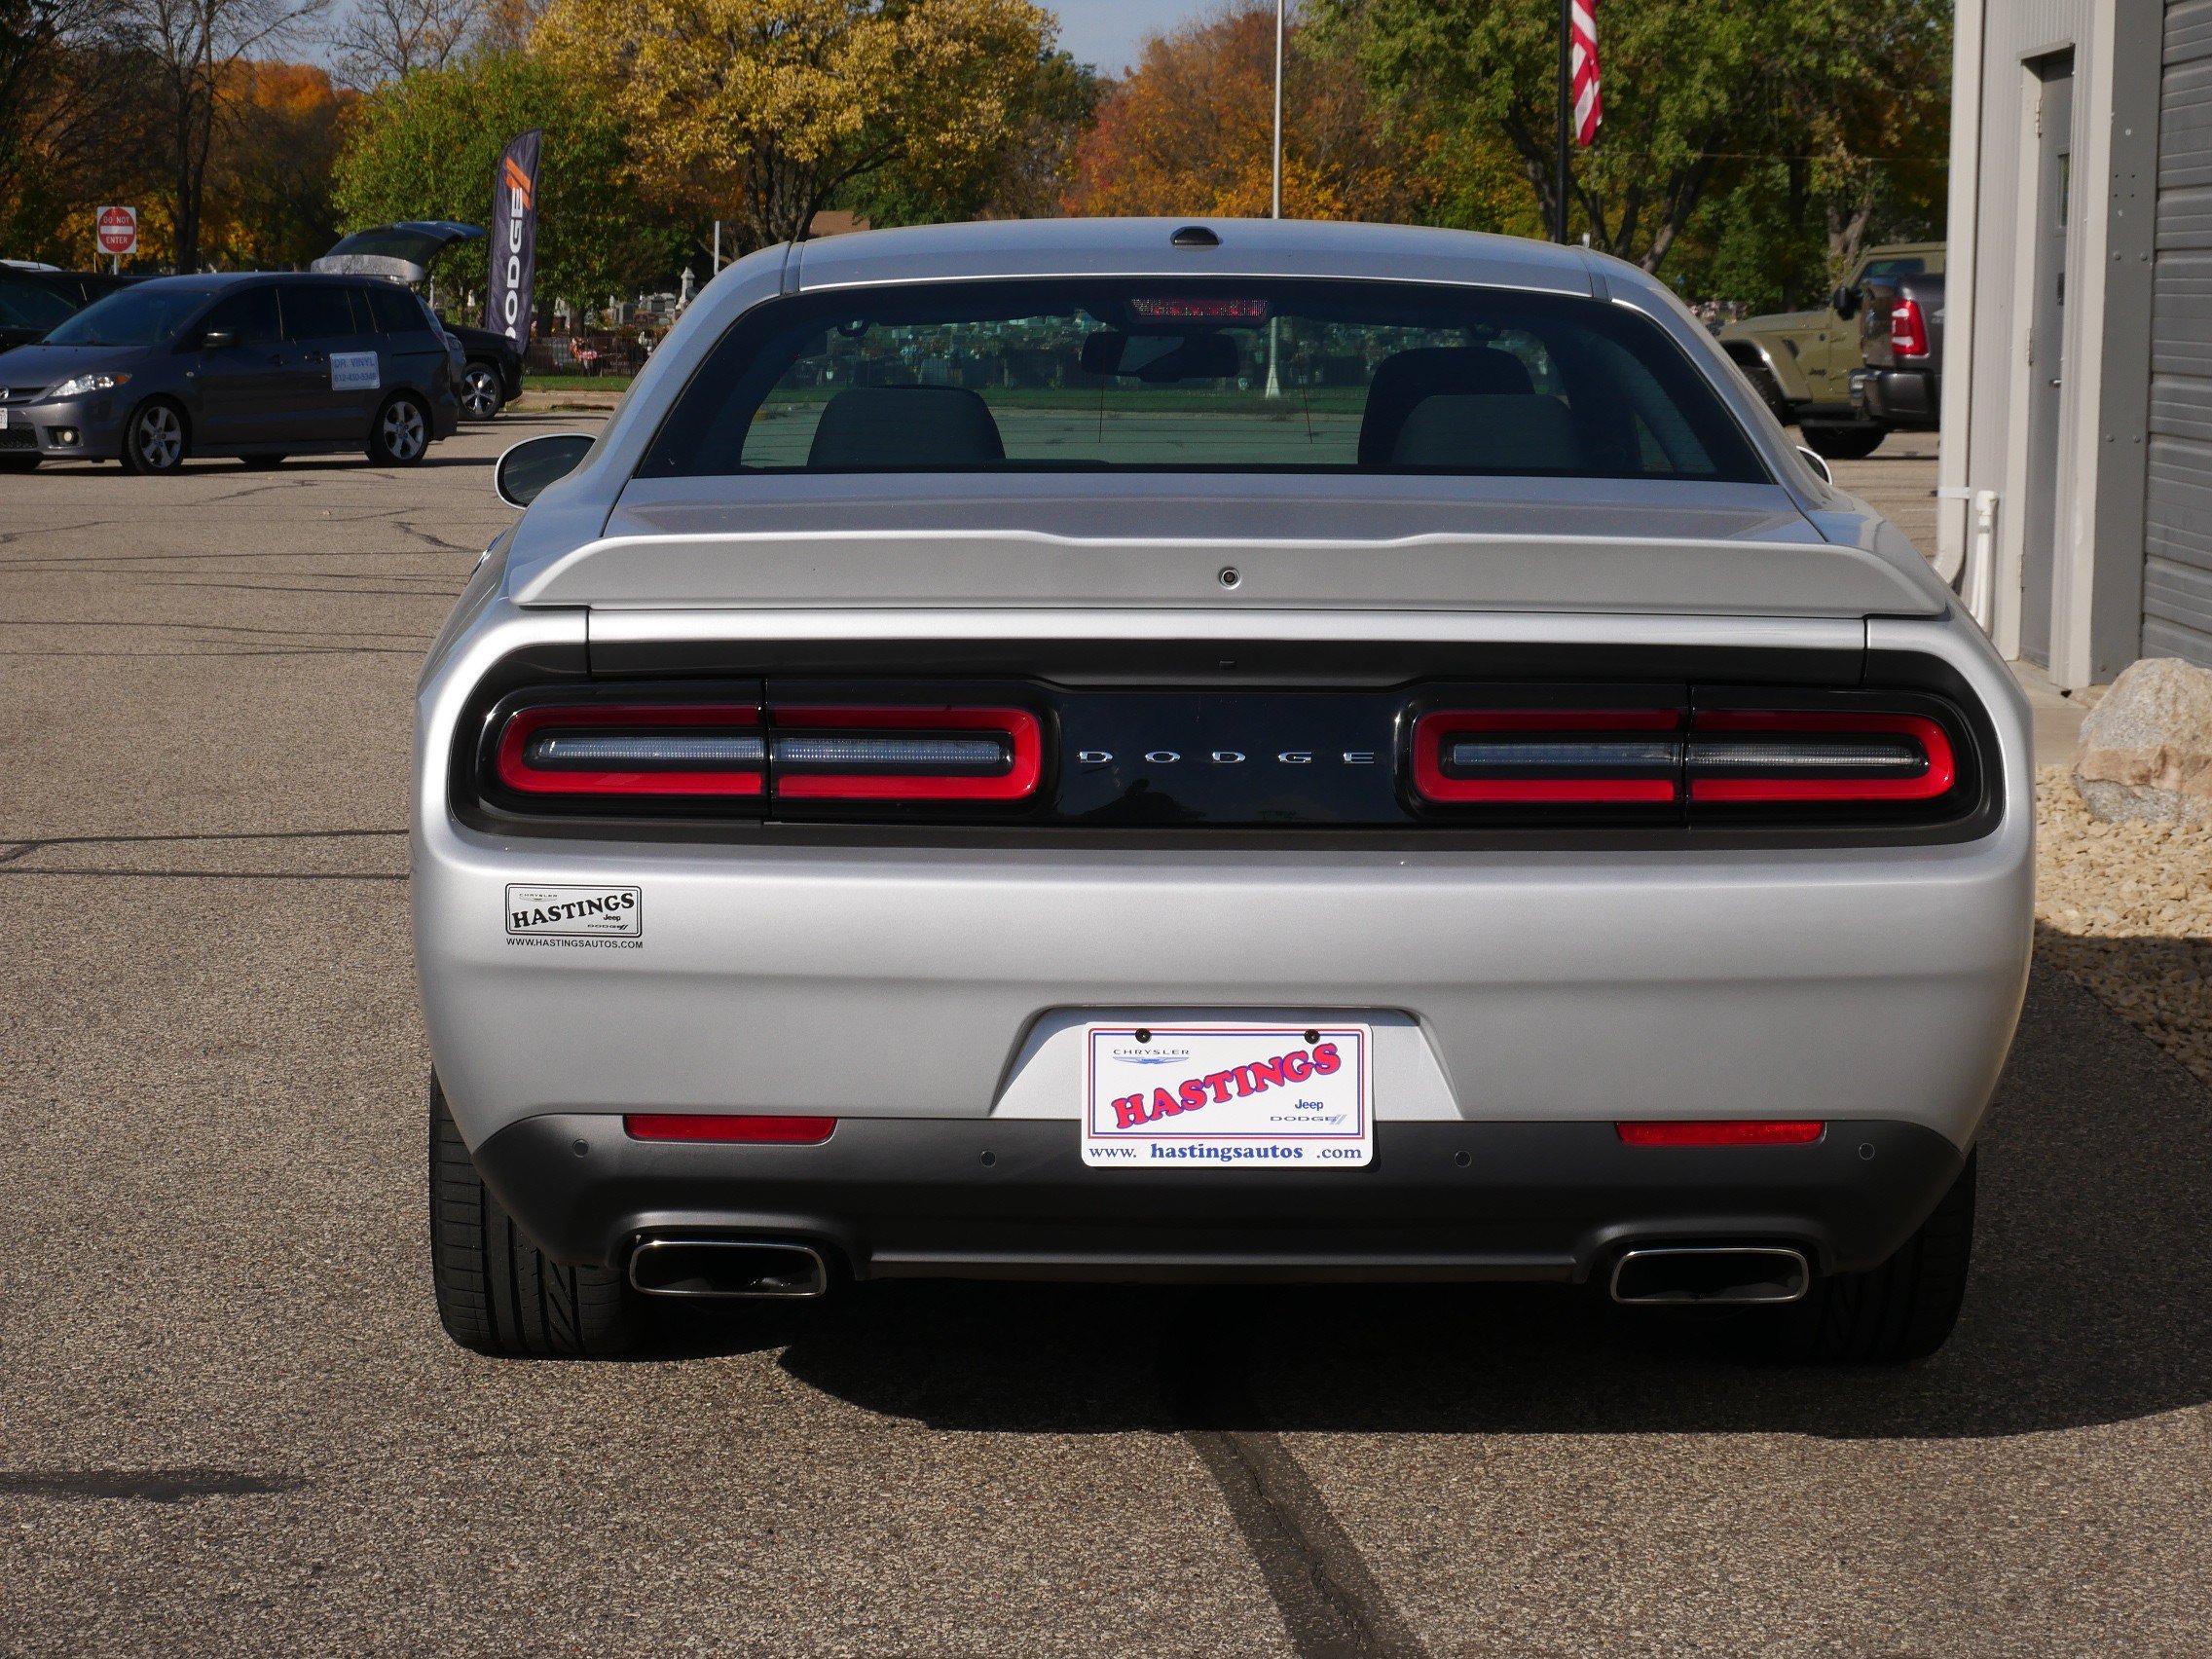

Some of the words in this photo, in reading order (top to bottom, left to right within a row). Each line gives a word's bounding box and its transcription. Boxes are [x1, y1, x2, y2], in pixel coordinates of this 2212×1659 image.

[350, 356, 376, 367] VINYL
[1077, 751, 1375, 764] DODGE
[511, 892, 635, 928] HASTINGS
[603, 913, 621, 922] Jeep
[506, 938, 644, 949] WWW.HASTINGSAUTOS.COM
[1111, 1043, 1342, 1129] HASTINGS
[1294, 1099, 1324, 1112] Jeep
[1088, 1147, 1137, 1159] www.
[1150, 1143, 1304, 1161] hastingsautos
[1316, 1148, 1363, 1159] .com
